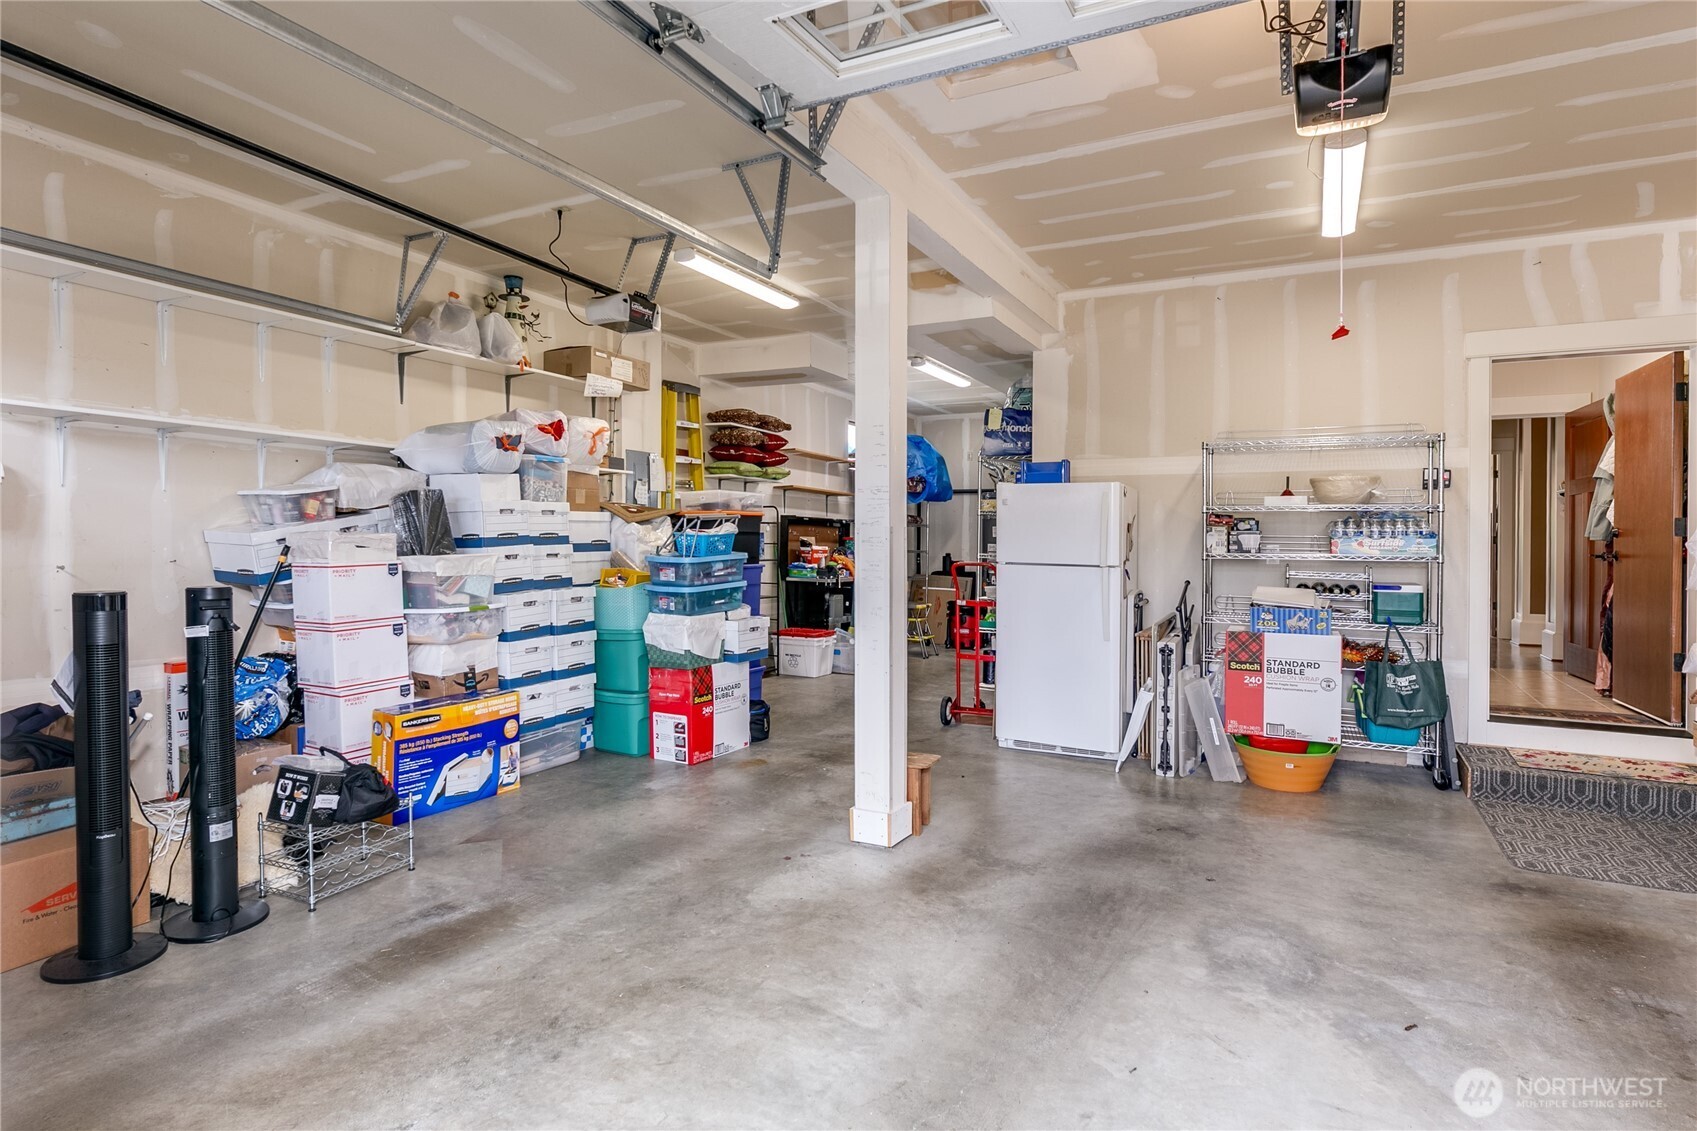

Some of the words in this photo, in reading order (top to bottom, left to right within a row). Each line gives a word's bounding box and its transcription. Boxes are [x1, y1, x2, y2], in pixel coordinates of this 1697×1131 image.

[1230, 661, 1261, 671] Scotch
[1266, 659, 1321, 670] STANDARD
[1266, 666, 1306, 676] BUBBLE
[1243, 675, 1263, 685] 240
[1266, 673, 1297, 681] CUSHION
[714, 682, 742, 694] STANDARD
[344, 695, 368, 703] PRIORITY
[694, 694, 712, 704] Scotch
[715, 690, 734, 700] BUBBLE
[702, 705, 714, 714] 240
[402, 717, 429, 727] BANKERS
[433, 735, 452, 743] Stacking
[45, 890, 77, 906] SERV
[41, 910, 58, 919] Water
